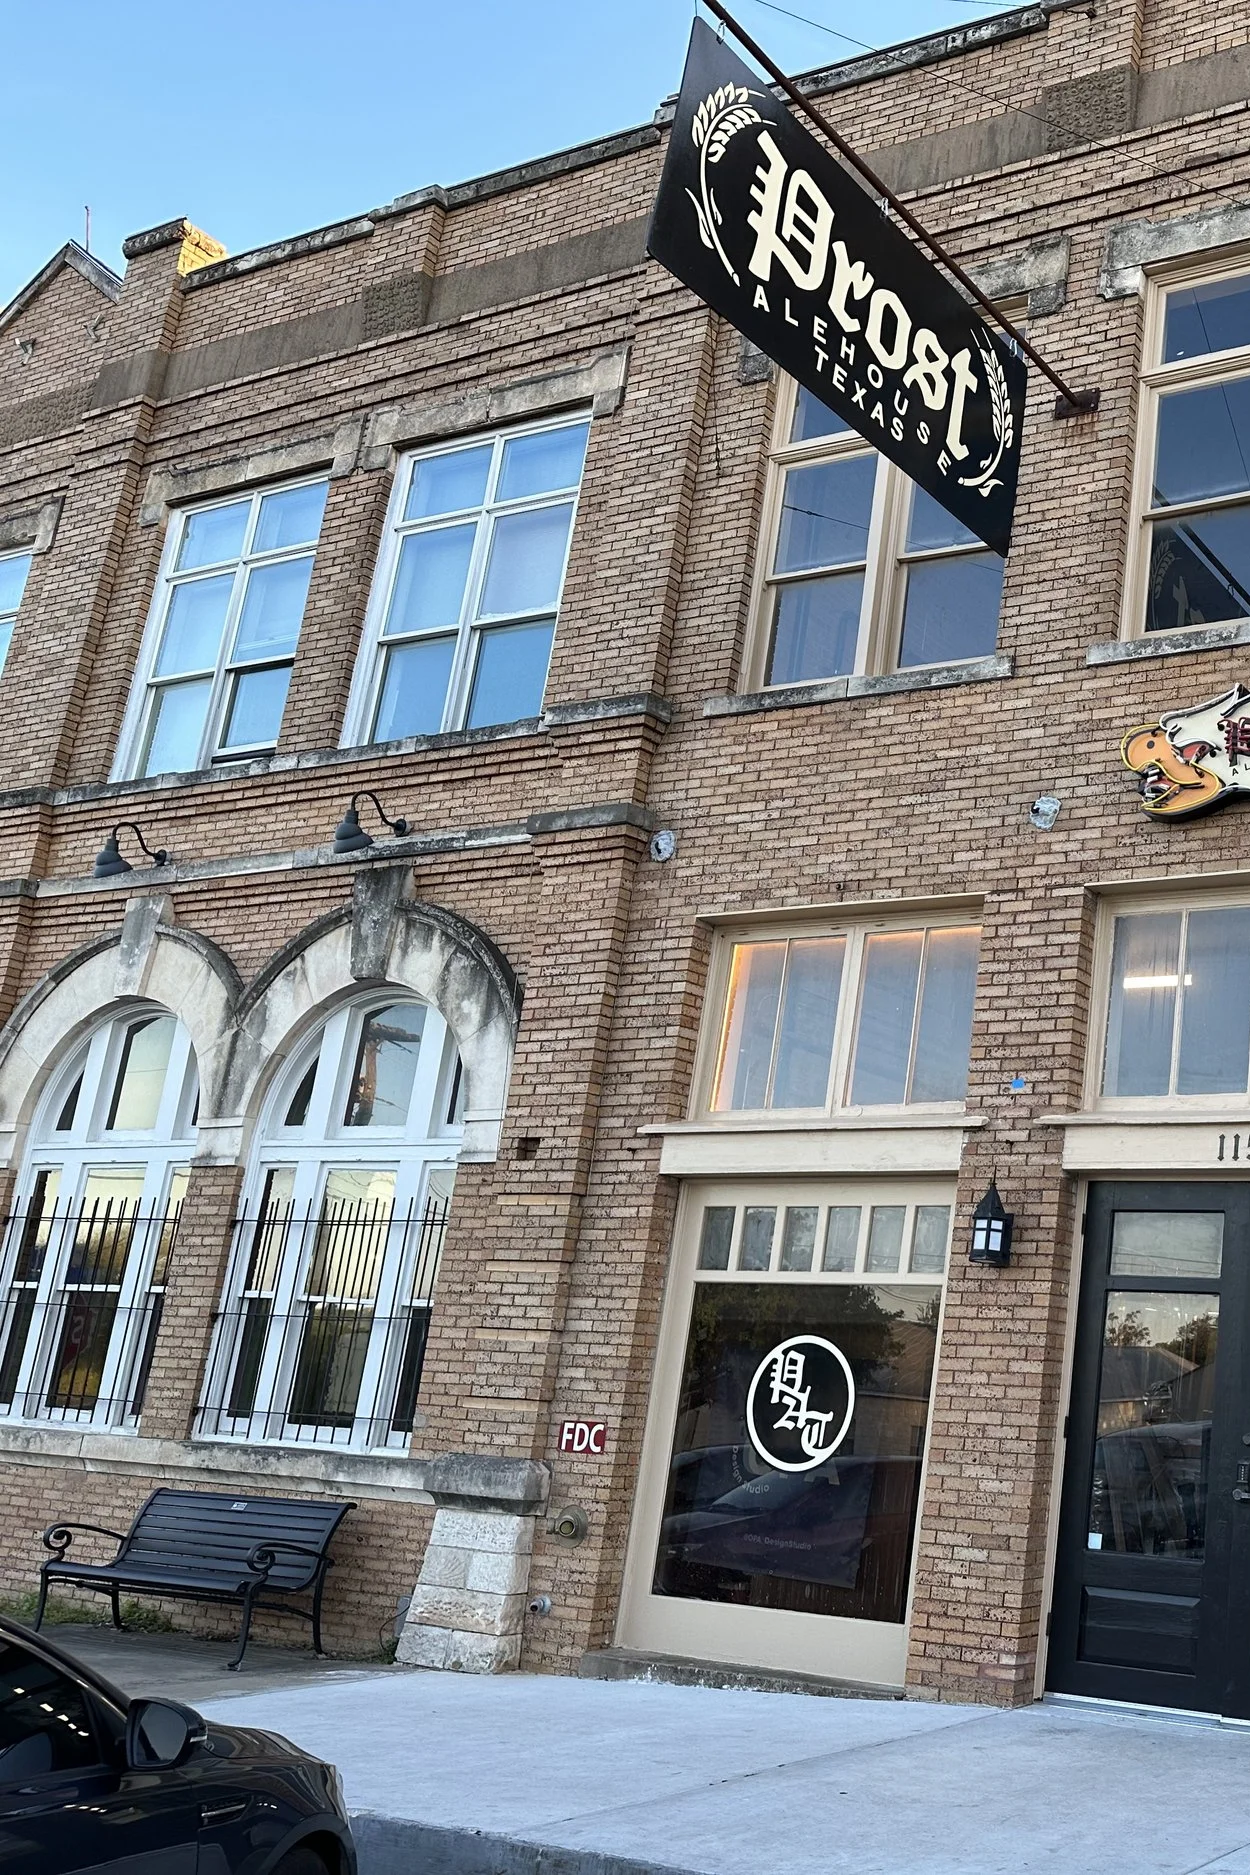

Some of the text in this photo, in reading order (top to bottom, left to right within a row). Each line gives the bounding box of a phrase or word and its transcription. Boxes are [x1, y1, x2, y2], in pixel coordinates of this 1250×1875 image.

[747, 129, 979, 461] Prost
[753, 284, 952, 476] ALEHOUSE
[814, 345, 905, 442] TEXAS
[560, 1422, 605, 1453] FDC
